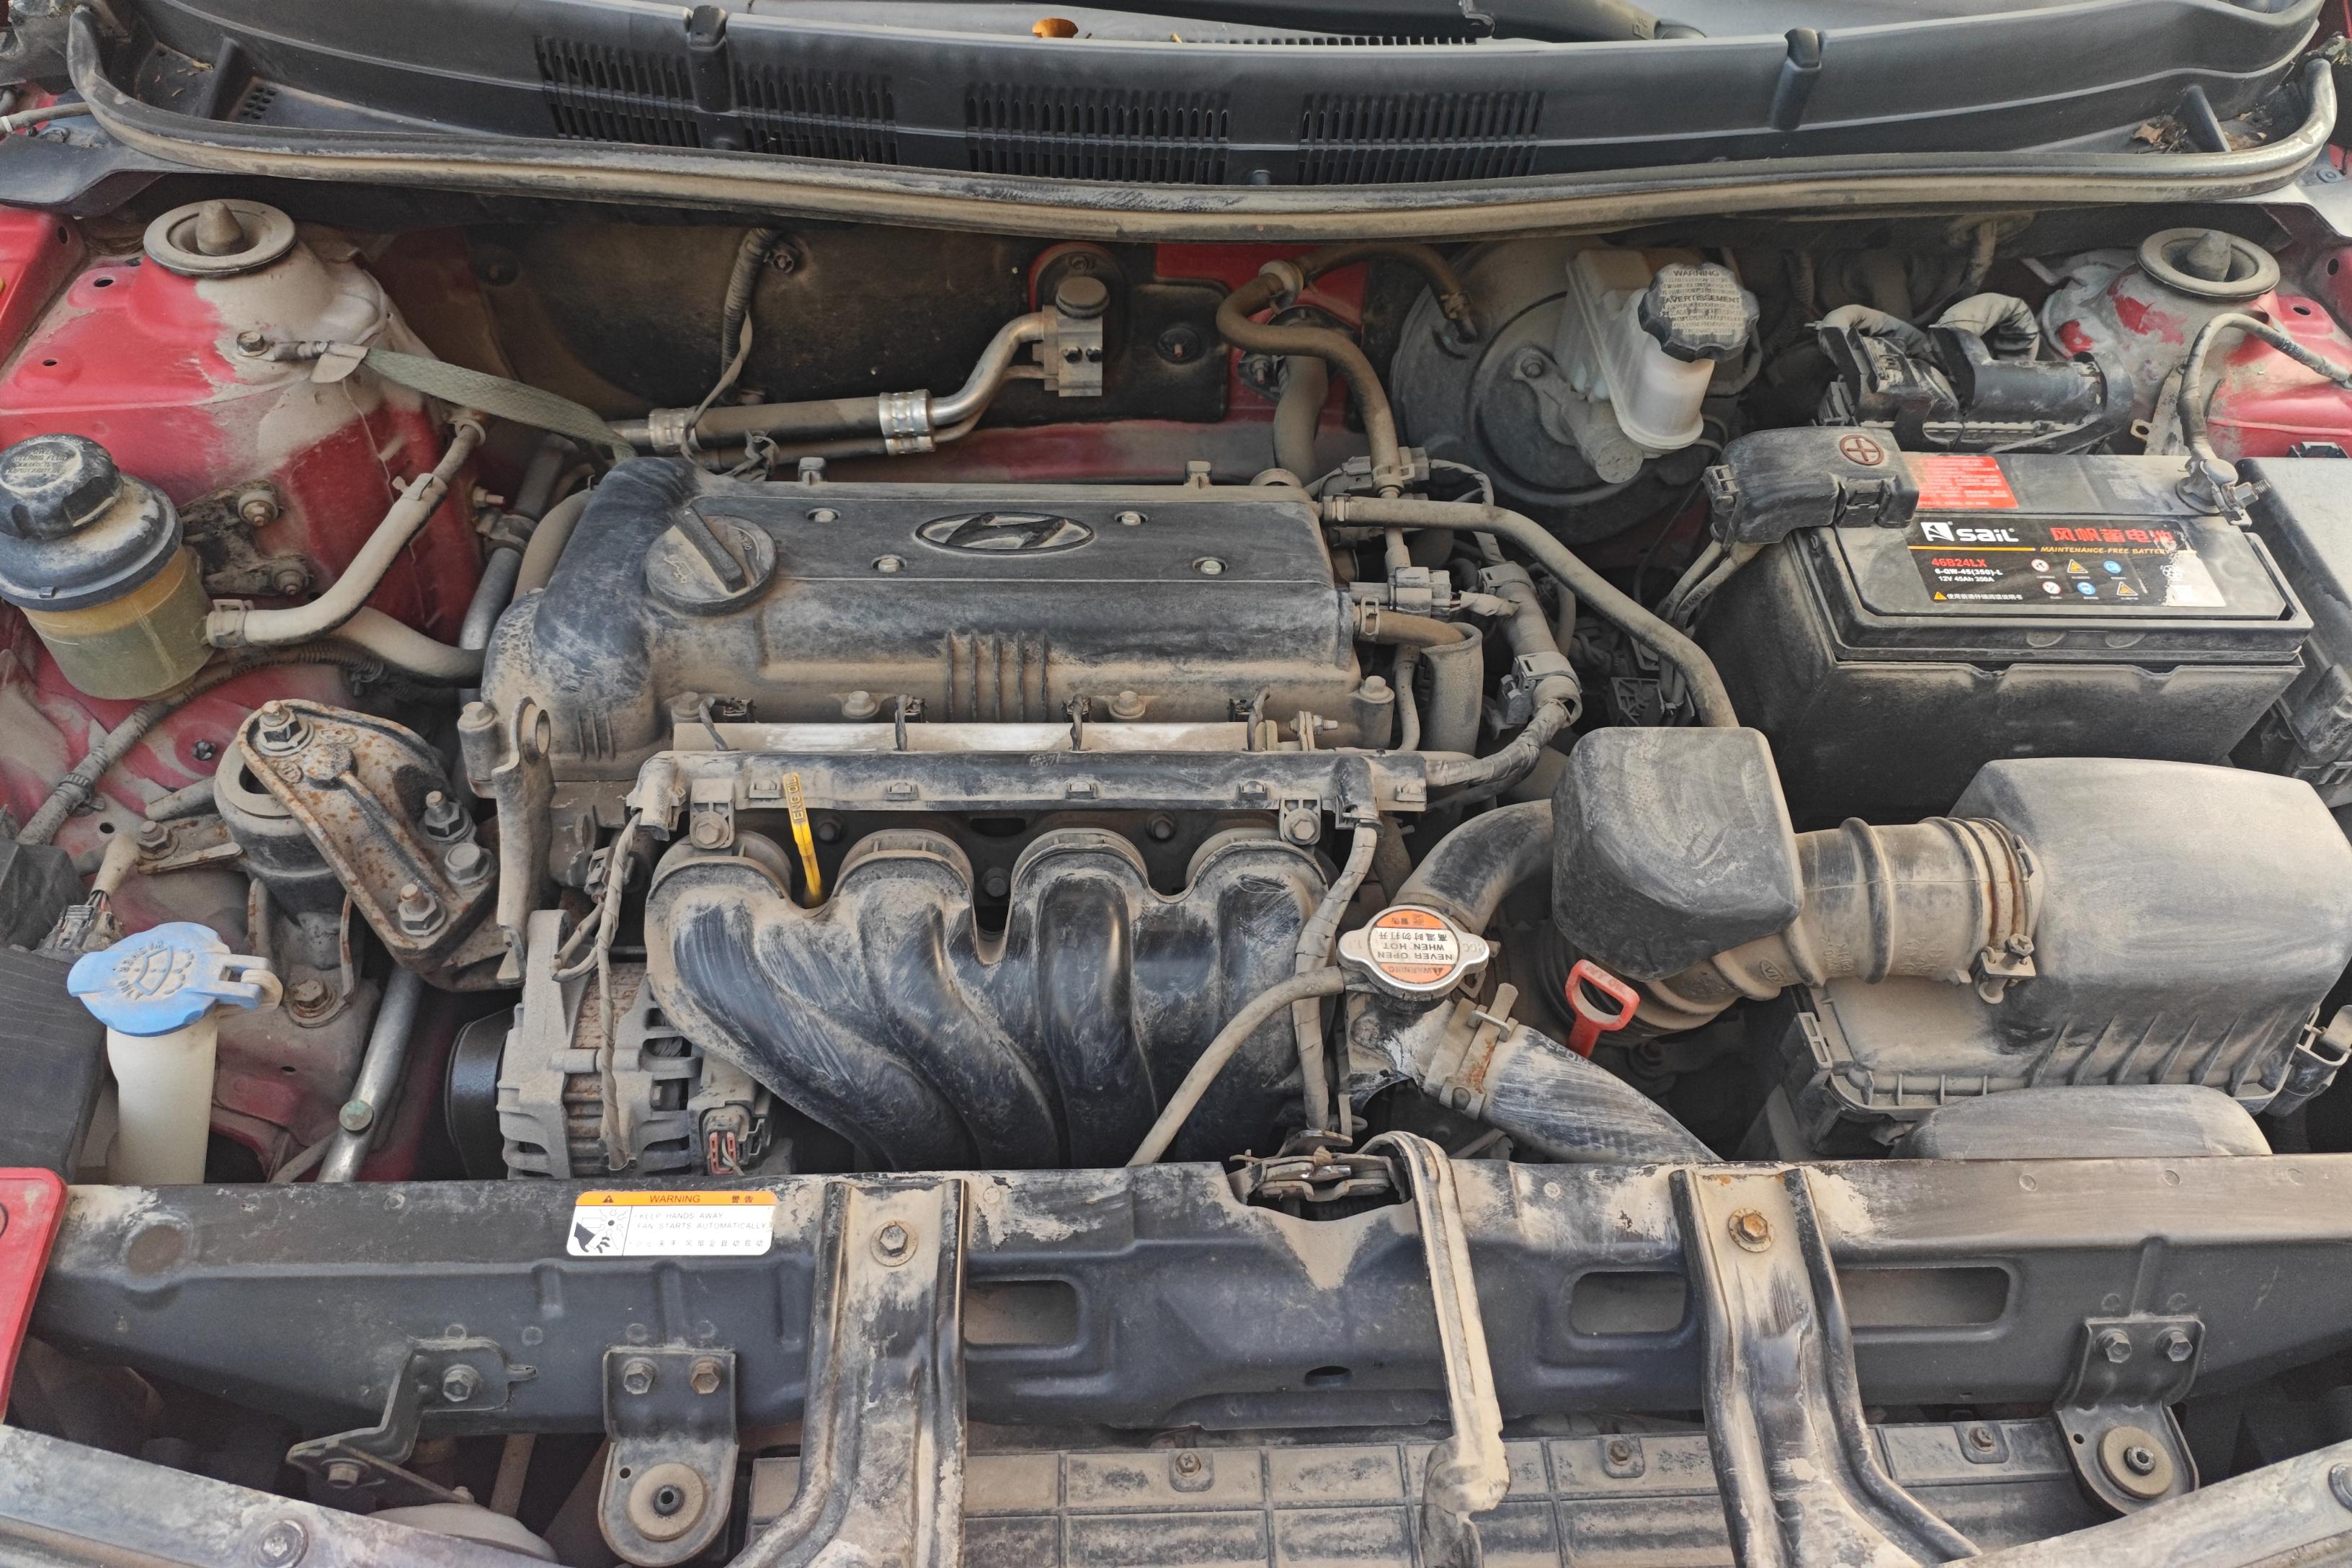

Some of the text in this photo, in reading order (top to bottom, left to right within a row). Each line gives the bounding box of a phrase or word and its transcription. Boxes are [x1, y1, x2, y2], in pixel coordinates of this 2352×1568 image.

[1665, 295, 1741, 304] AVERTISSEMENT
[2049, 527, 2175, 543] 风帆蓄电池
[1931, 558, 1988, 568] 46B24LX
[787, 775, 804, 820] ENG OIL
[1378, 931, 1448, 942] 高温时勿打开
[649, 1194, 701, 1203] WARNING
